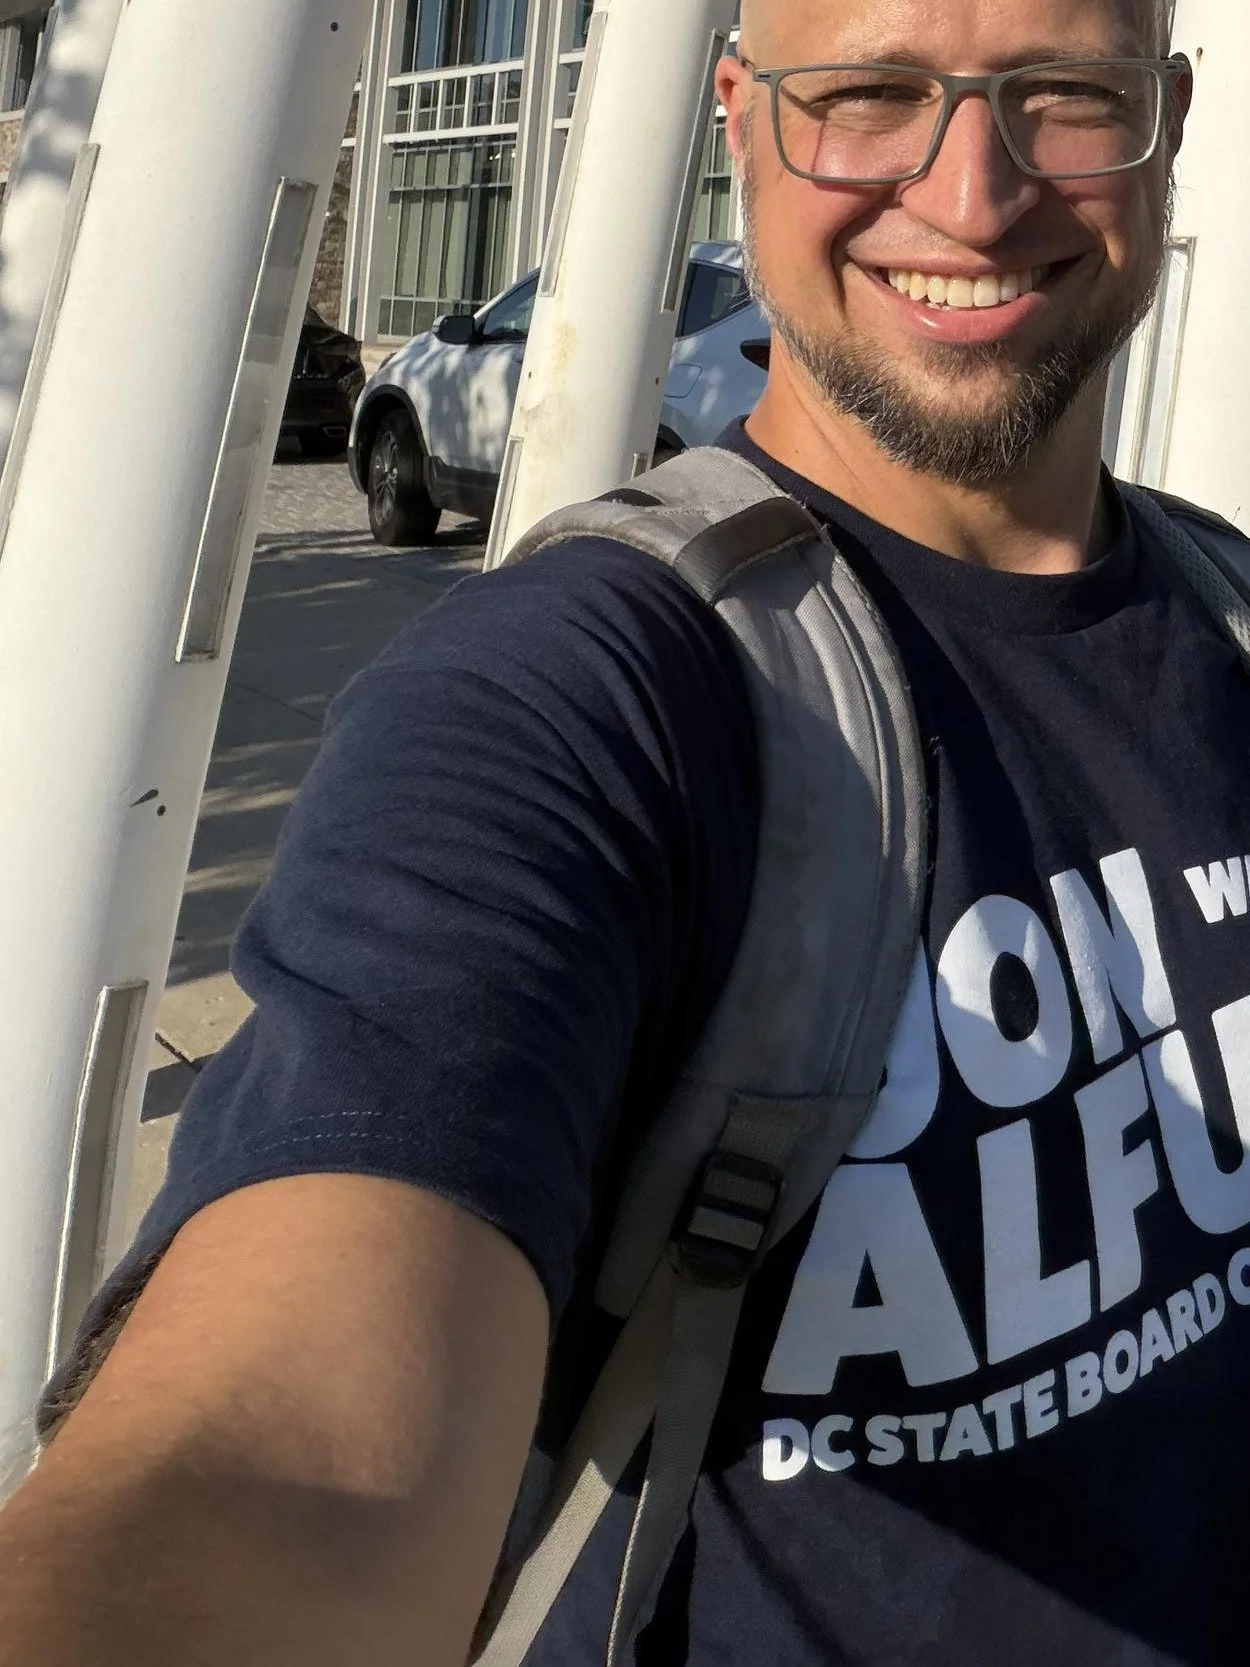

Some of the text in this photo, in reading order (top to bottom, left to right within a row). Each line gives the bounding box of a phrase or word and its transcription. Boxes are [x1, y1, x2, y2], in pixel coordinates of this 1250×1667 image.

[762, 1415, 857, 1483] DC
[867, 1366, 1062, 1468] STATE
[1064, 1280, 1226, 1419] BOARD
